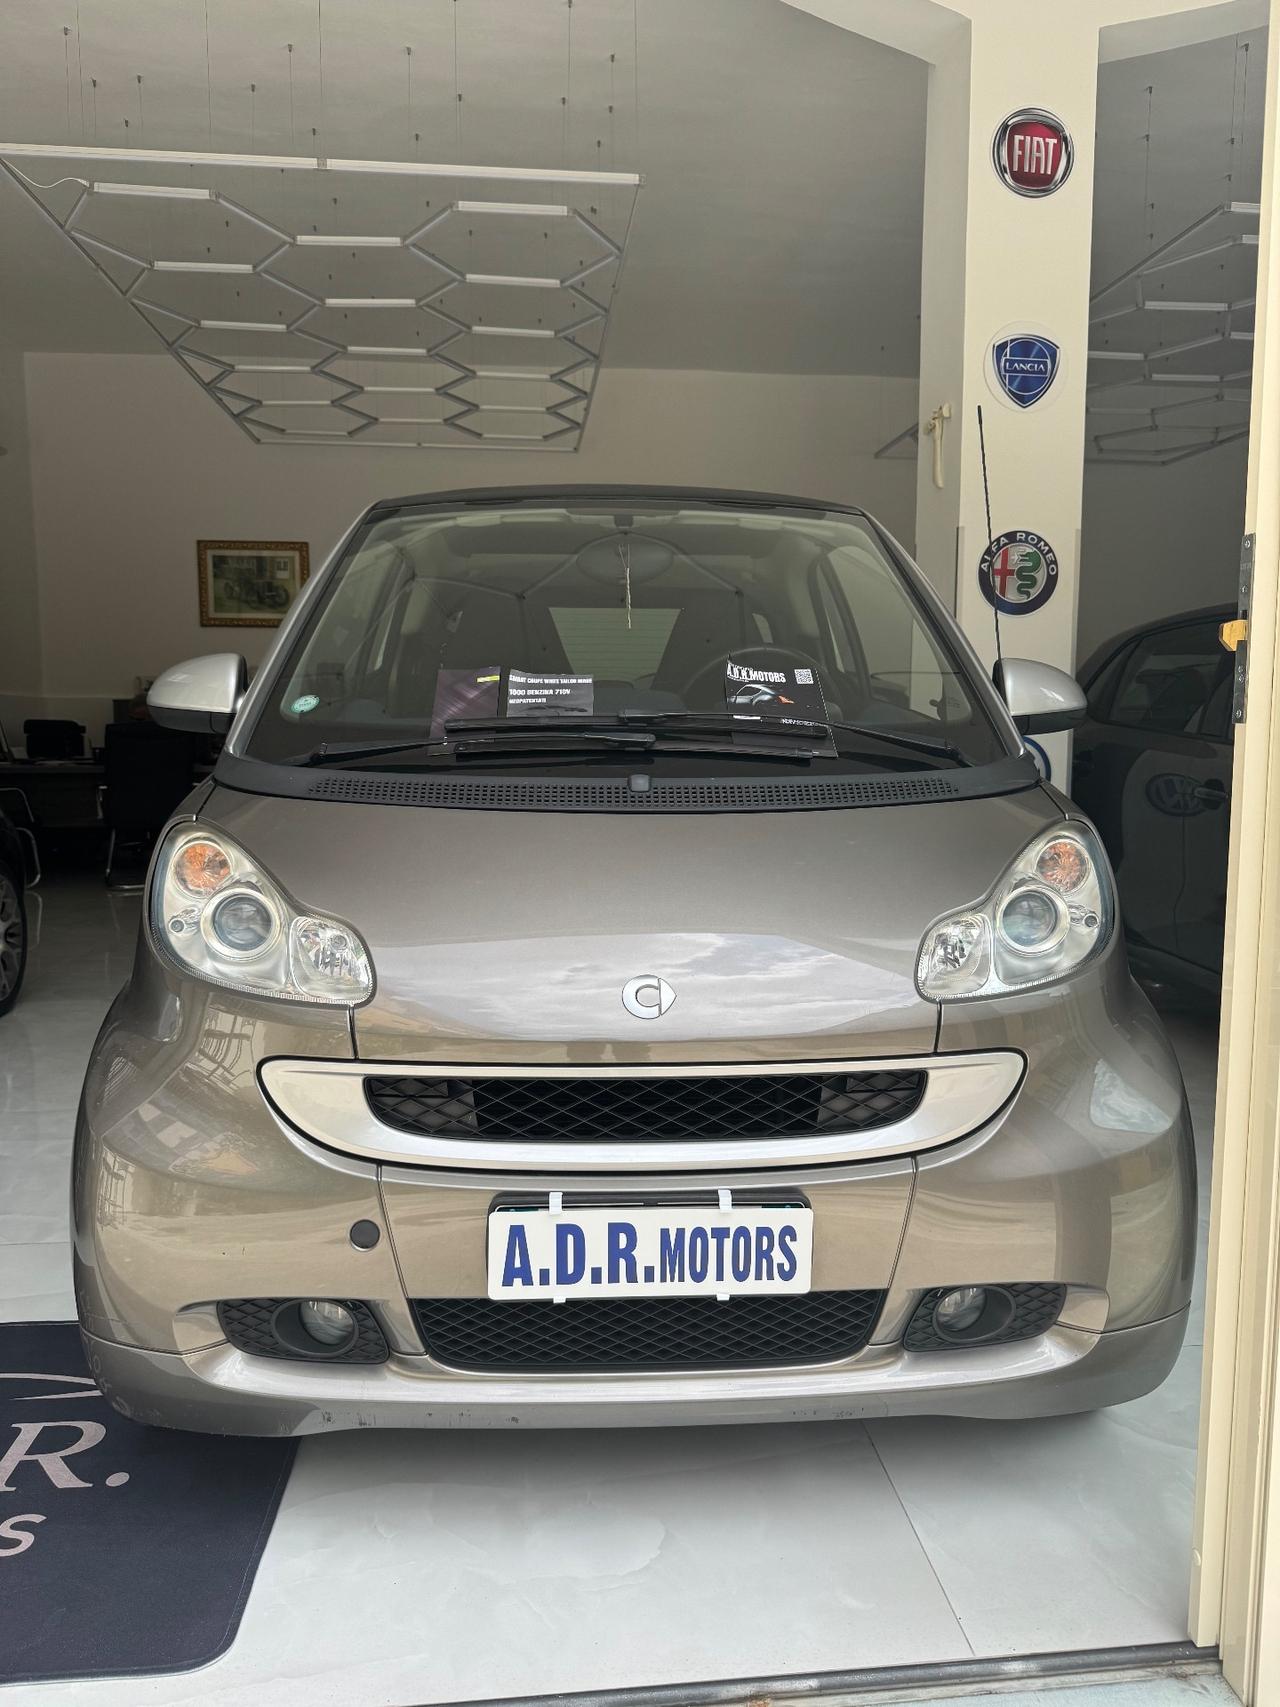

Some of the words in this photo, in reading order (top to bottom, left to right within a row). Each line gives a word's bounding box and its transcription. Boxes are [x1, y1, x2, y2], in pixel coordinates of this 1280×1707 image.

[1013, 135, 1057, 174] FIAT
[1006, 362, 1045, 372] LANCIA
[1016, 532, 1057, 576] ROMEO
